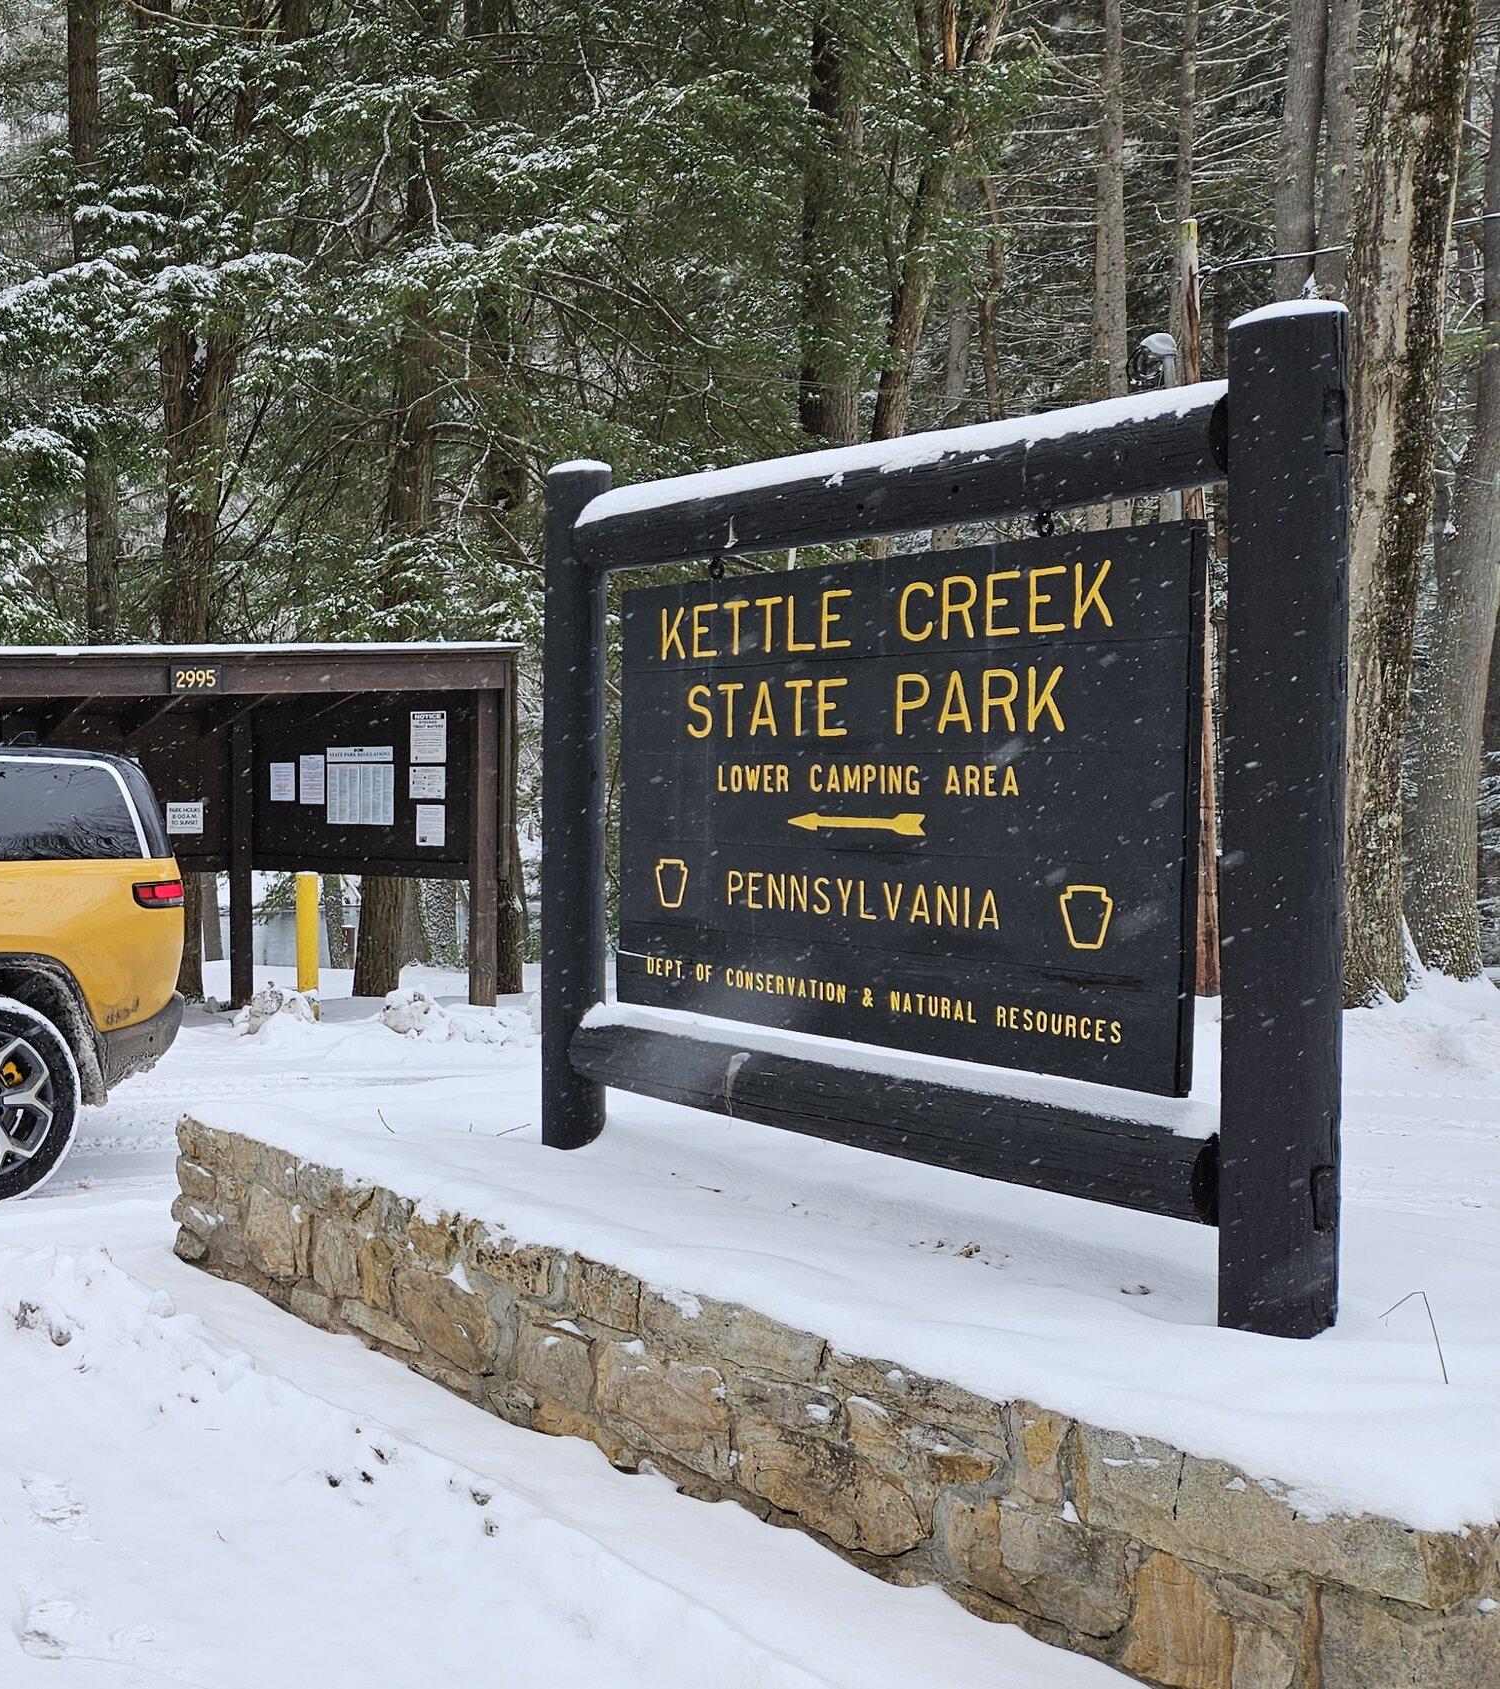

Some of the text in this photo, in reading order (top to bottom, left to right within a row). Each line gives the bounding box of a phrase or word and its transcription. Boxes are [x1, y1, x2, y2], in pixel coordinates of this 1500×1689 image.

[661, 559, 1113, 660] KETTLE CREEK
[175, 669, 216, 688] 2995
[686, 665, 1066, 739] STATE PARK
[717, 763, 1019, 797] LOWER CAMPING AREA
[727, 870, 999, 931] PENNSYLVANIA
[646, 956, 1122, 1044] DEPT. OF CONSERVATION & NATURAL RESOURCES
